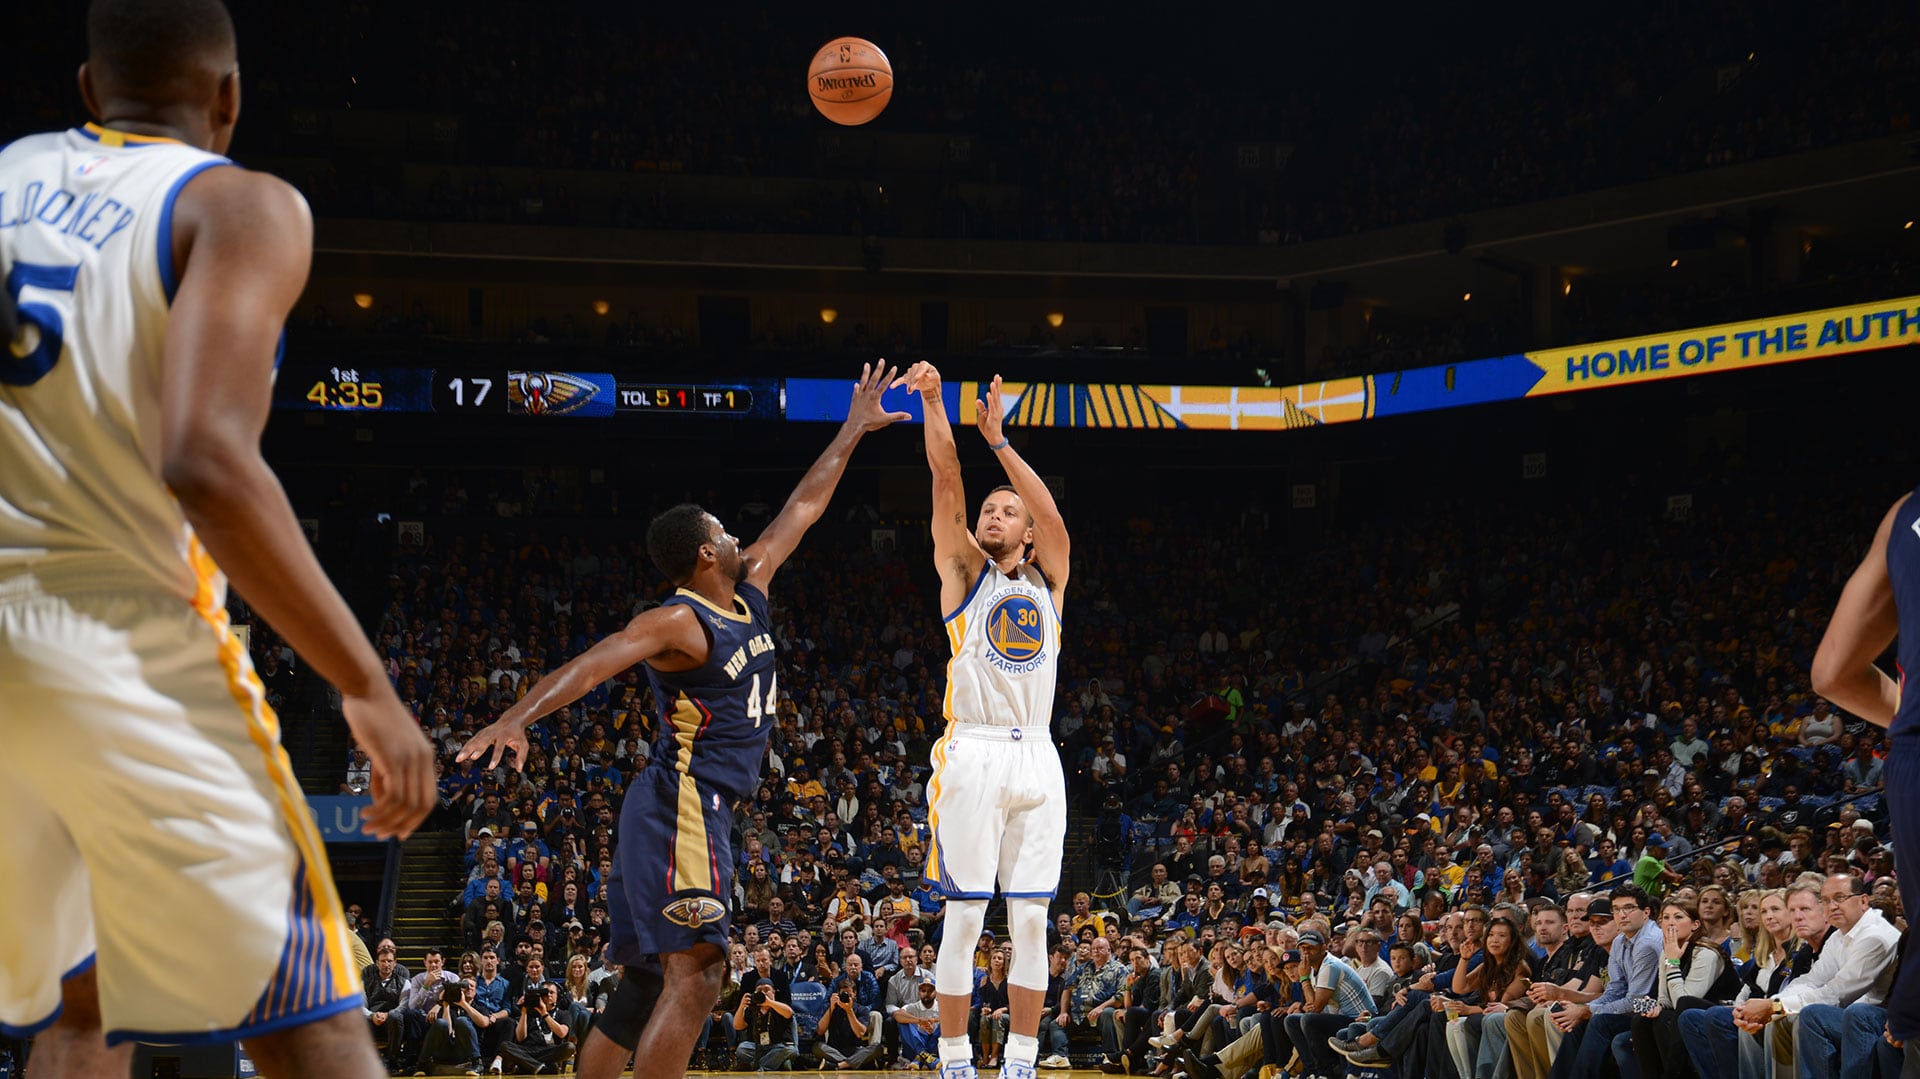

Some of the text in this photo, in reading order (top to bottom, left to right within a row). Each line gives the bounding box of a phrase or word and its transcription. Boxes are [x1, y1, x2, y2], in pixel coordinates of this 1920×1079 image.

[817, 72, 876, 92] SPALDING
[0, 180, 136, 250] LOONEY
[1565, 306, 1920, 383] HOME OF THE AUTH
[329, 366, 360, 383] 1st
[305, 379, 384, 409] 4:35
[448, 377, 493, 407] 17
[620, 388, 687, 409] TOL 5 1
[702, 389, 735, 409] TF 1
[986, 586, 1024, 607] GOLDEN
[1017, 608, 1038, 627] 30
[723, 645, 748, 681] NEW
[985, 648, 1047, 674] WARRIORS
[747, 670, 777, 729] 44
